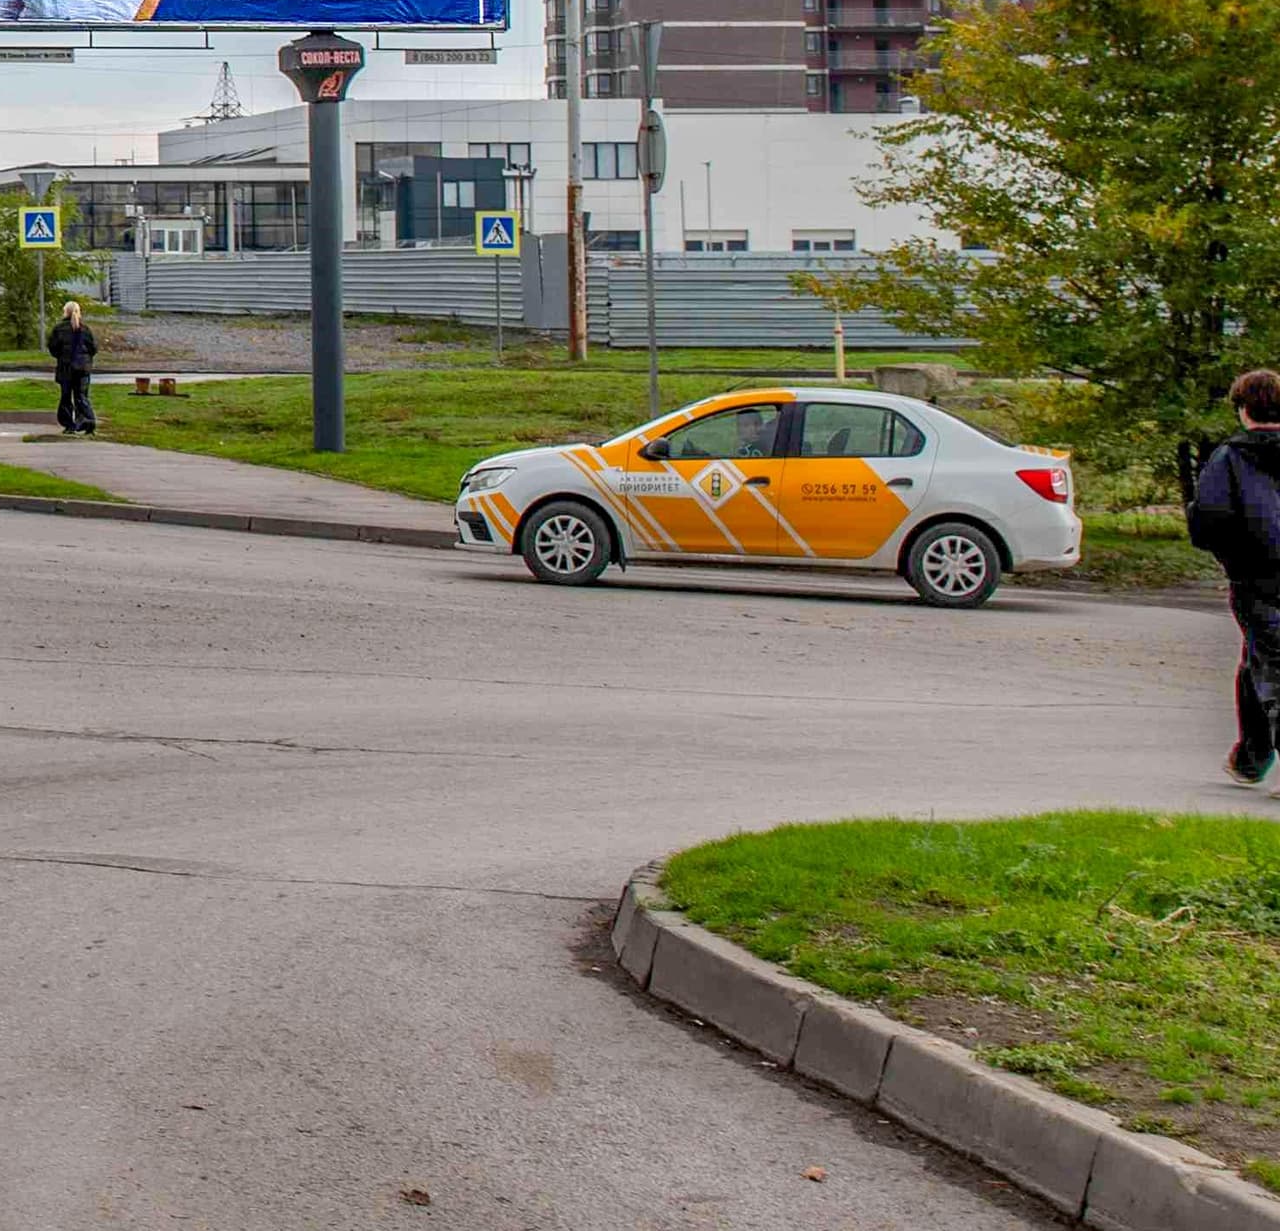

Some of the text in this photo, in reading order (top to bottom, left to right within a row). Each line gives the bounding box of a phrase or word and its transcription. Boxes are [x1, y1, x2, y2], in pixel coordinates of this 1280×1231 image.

[619, 482, 680, 492] ПРИОРИТЕТ
[814, 483, 877, 495] 256 57 59
